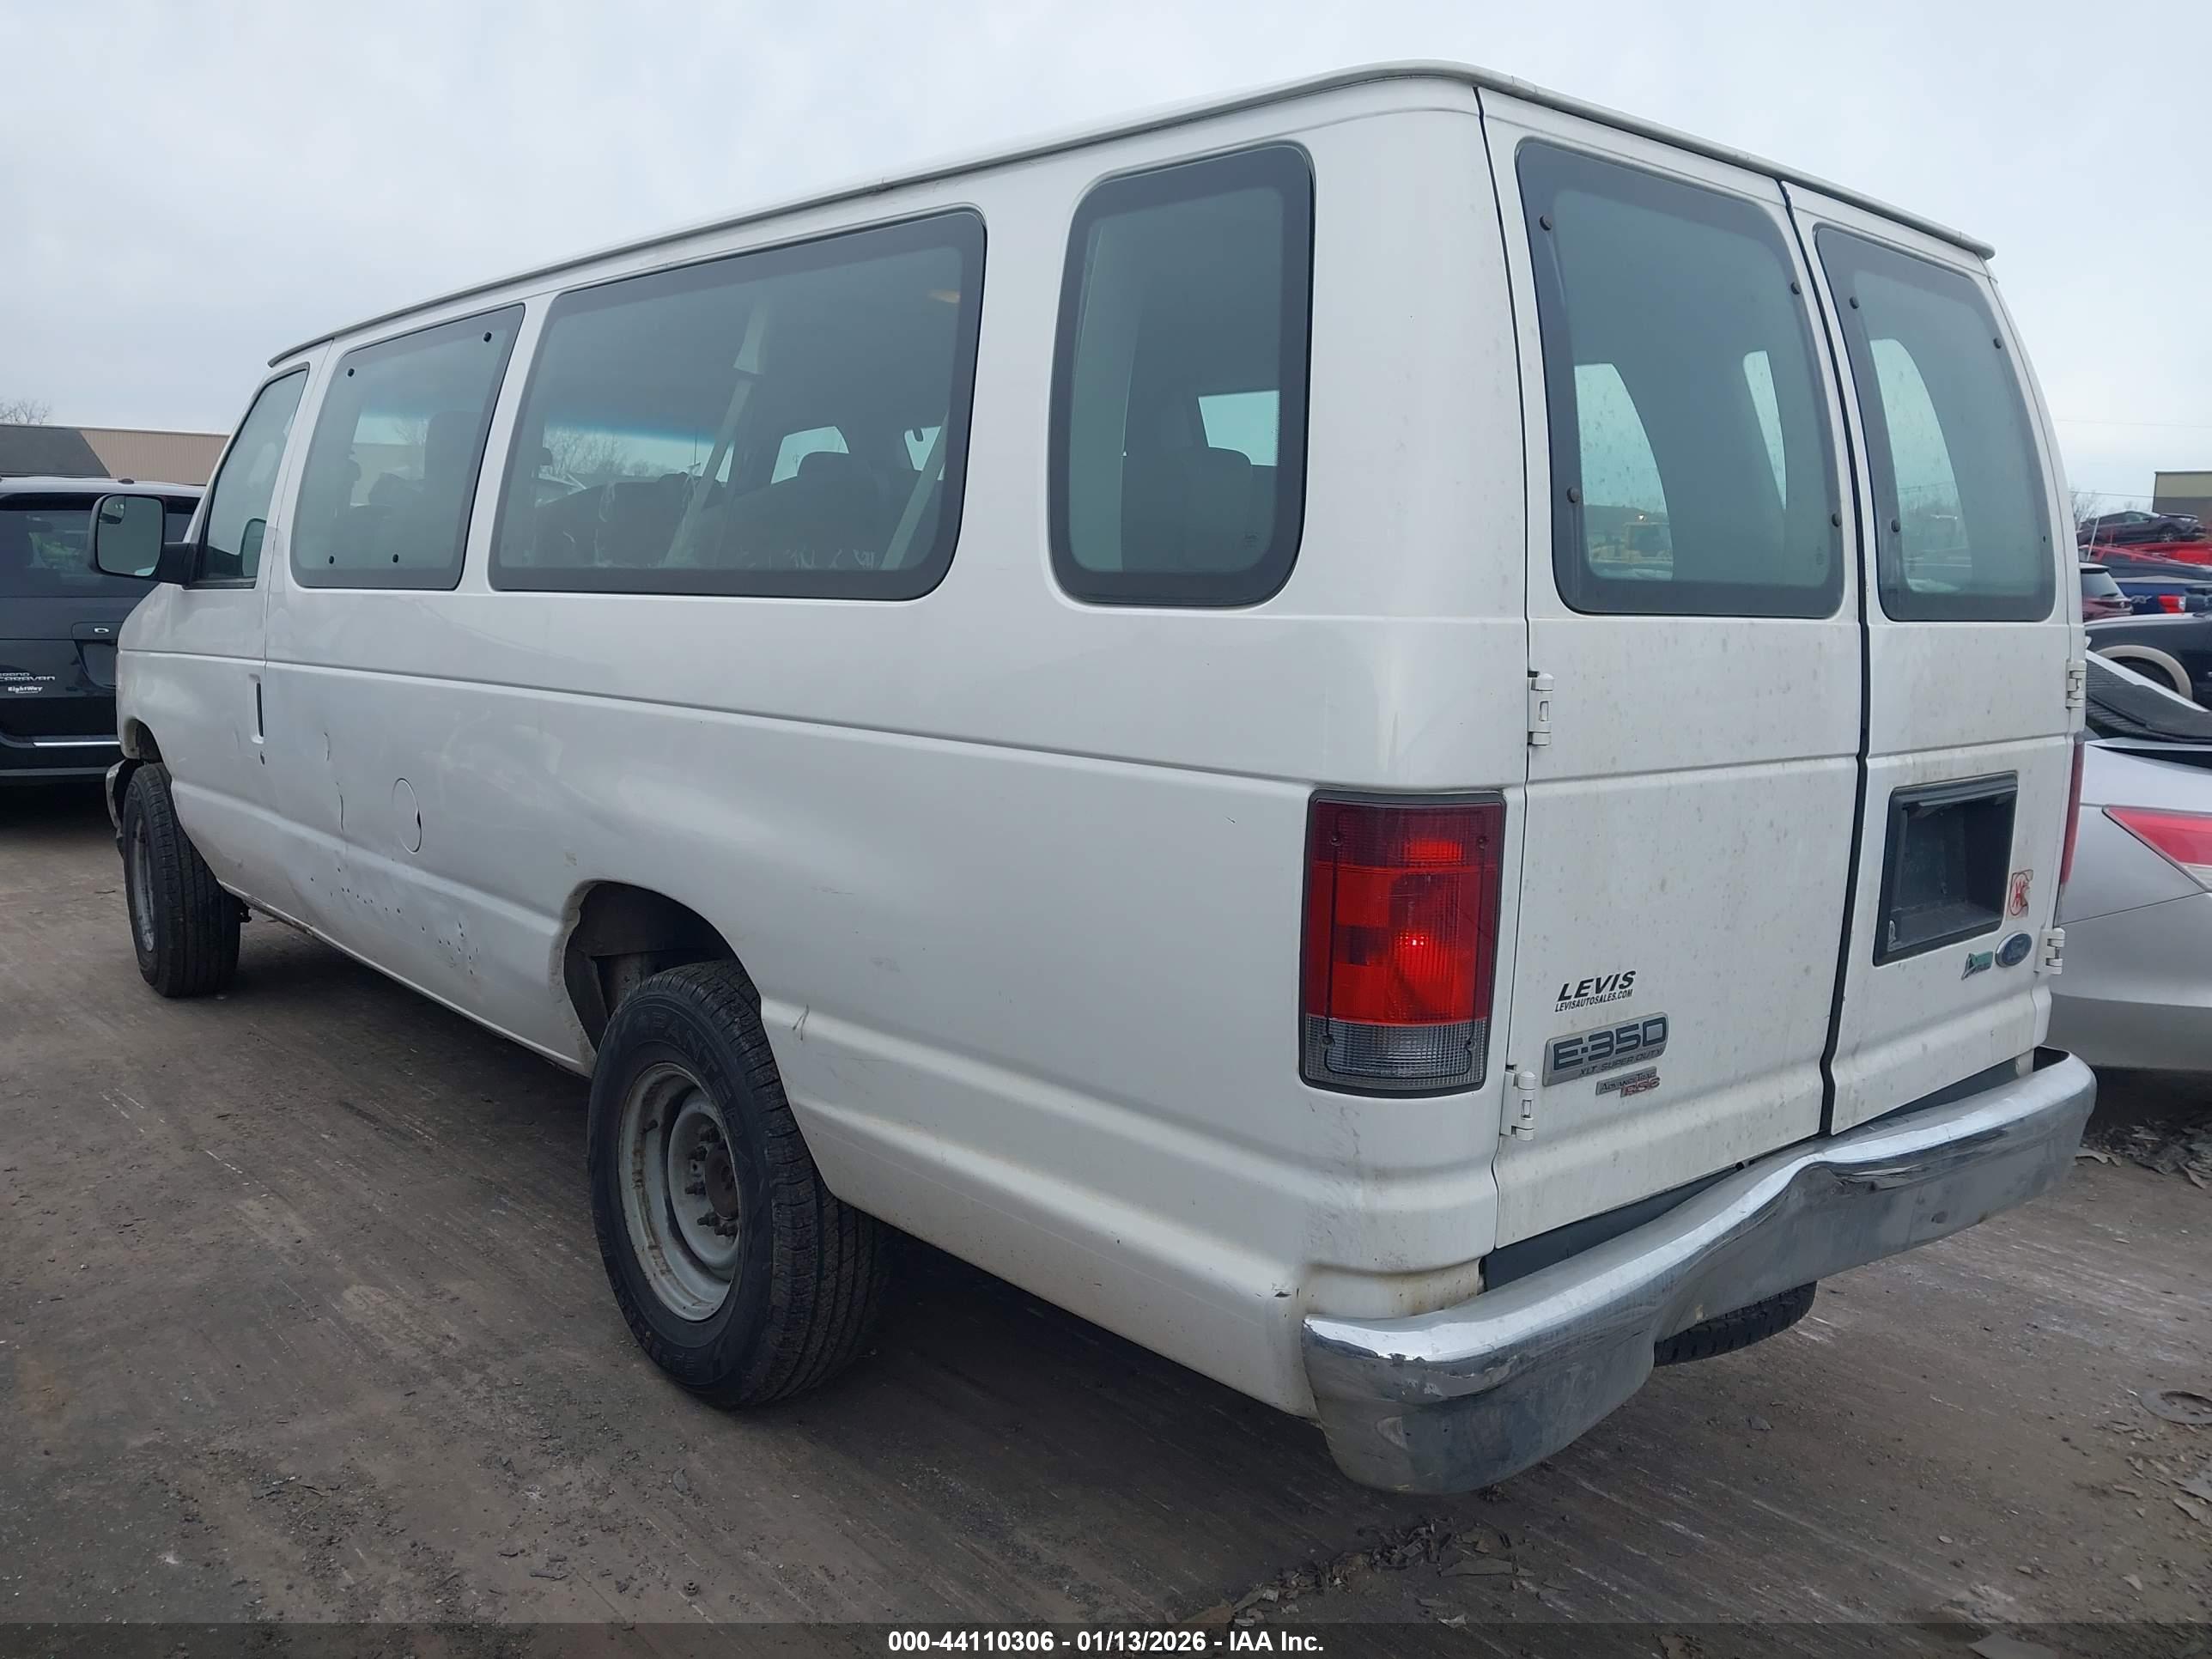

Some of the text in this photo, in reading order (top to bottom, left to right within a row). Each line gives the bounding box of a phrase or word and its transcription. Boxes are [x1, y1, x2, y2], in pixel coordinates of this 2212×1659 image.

[1558, 970, 1637, 1002] LEVIS
[1554, 989, 1633, 1012] LEVISAUTOSALES.COM
[1553, 1017, 1667, 1071] E-350
[1601, 1056, 1633, 1070] SUPER
[1636, 1048, 1662, 1060] DUTY
